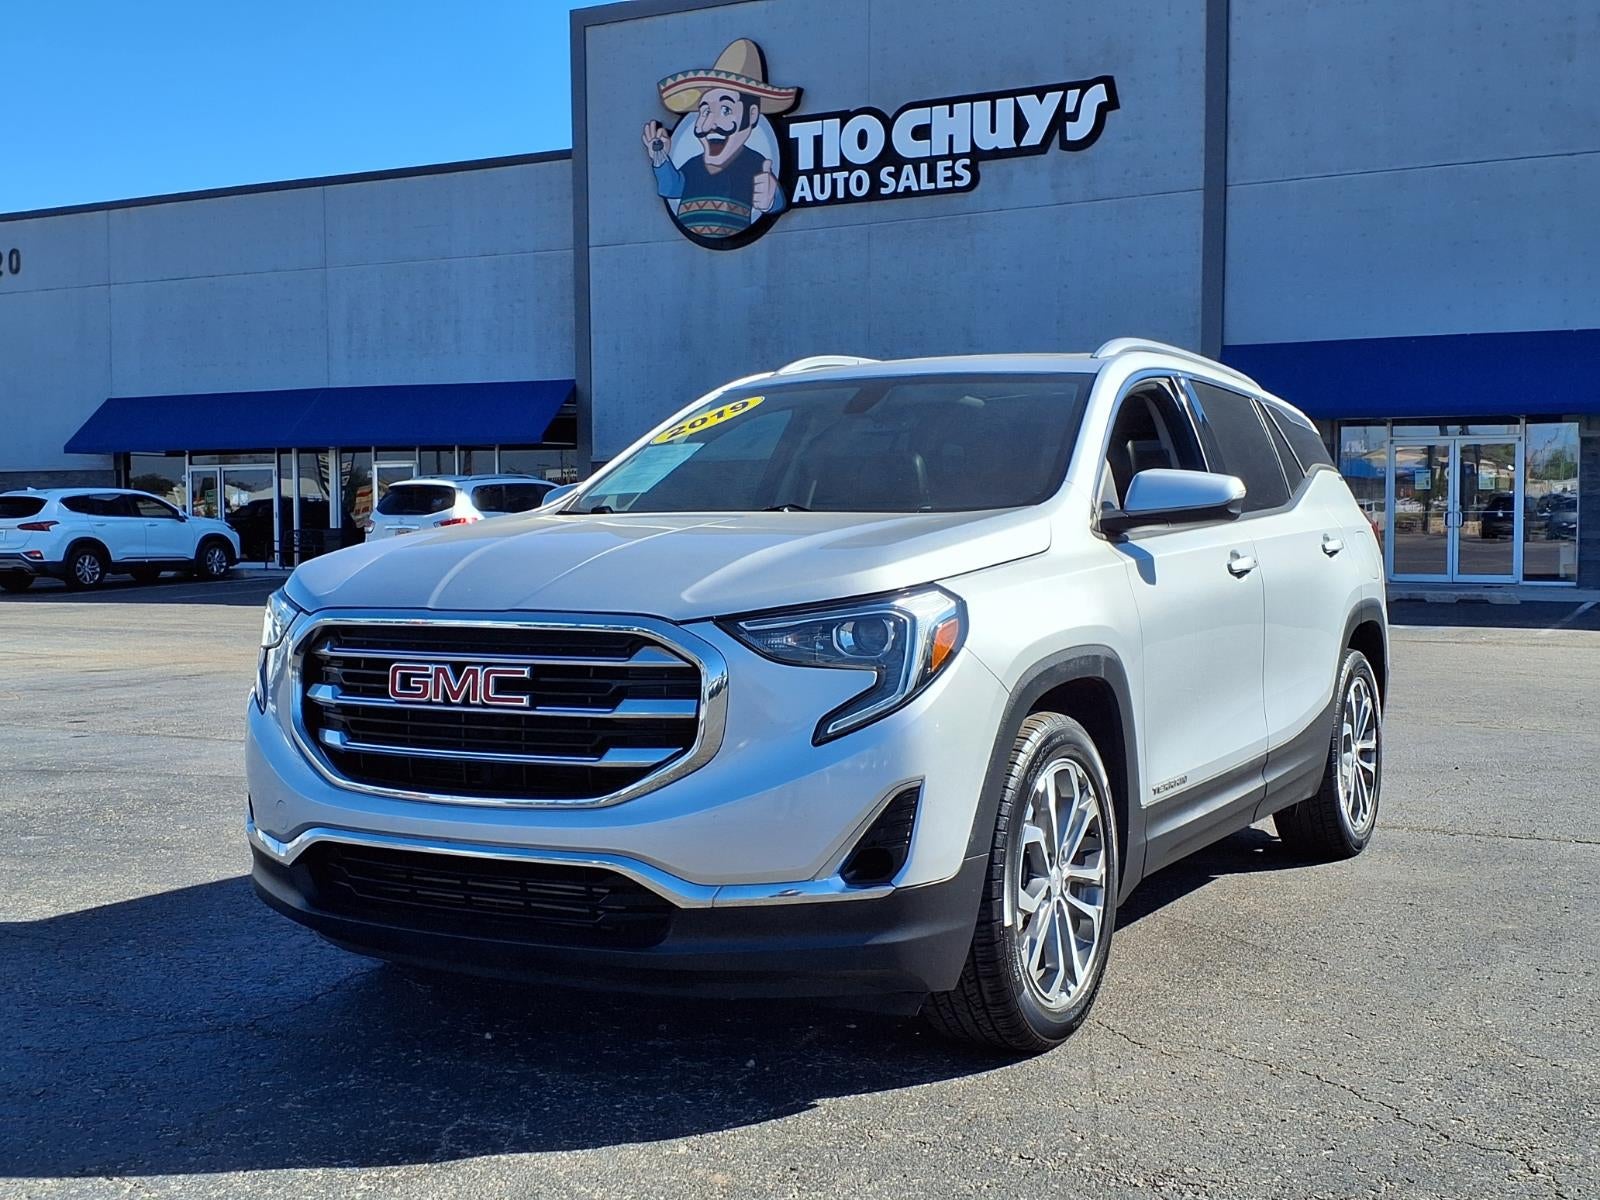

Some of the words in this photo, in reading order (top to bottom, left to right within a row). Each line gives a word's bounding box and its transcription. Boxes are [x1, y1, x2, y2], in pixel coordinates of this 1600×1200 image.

[789, 114, 886, 171] TIO
[891, 82, 1108, 159] CHUY'S
[791, 168, 870, 203] AUTO
[880, 158, 972, 195] SALES
[0, 248, 21, 276] 0
[667, 402, 749, 438] 2019
[388, 662, 532, 707] GMC
[1151, 775, 1188, 796] TERRAIN
